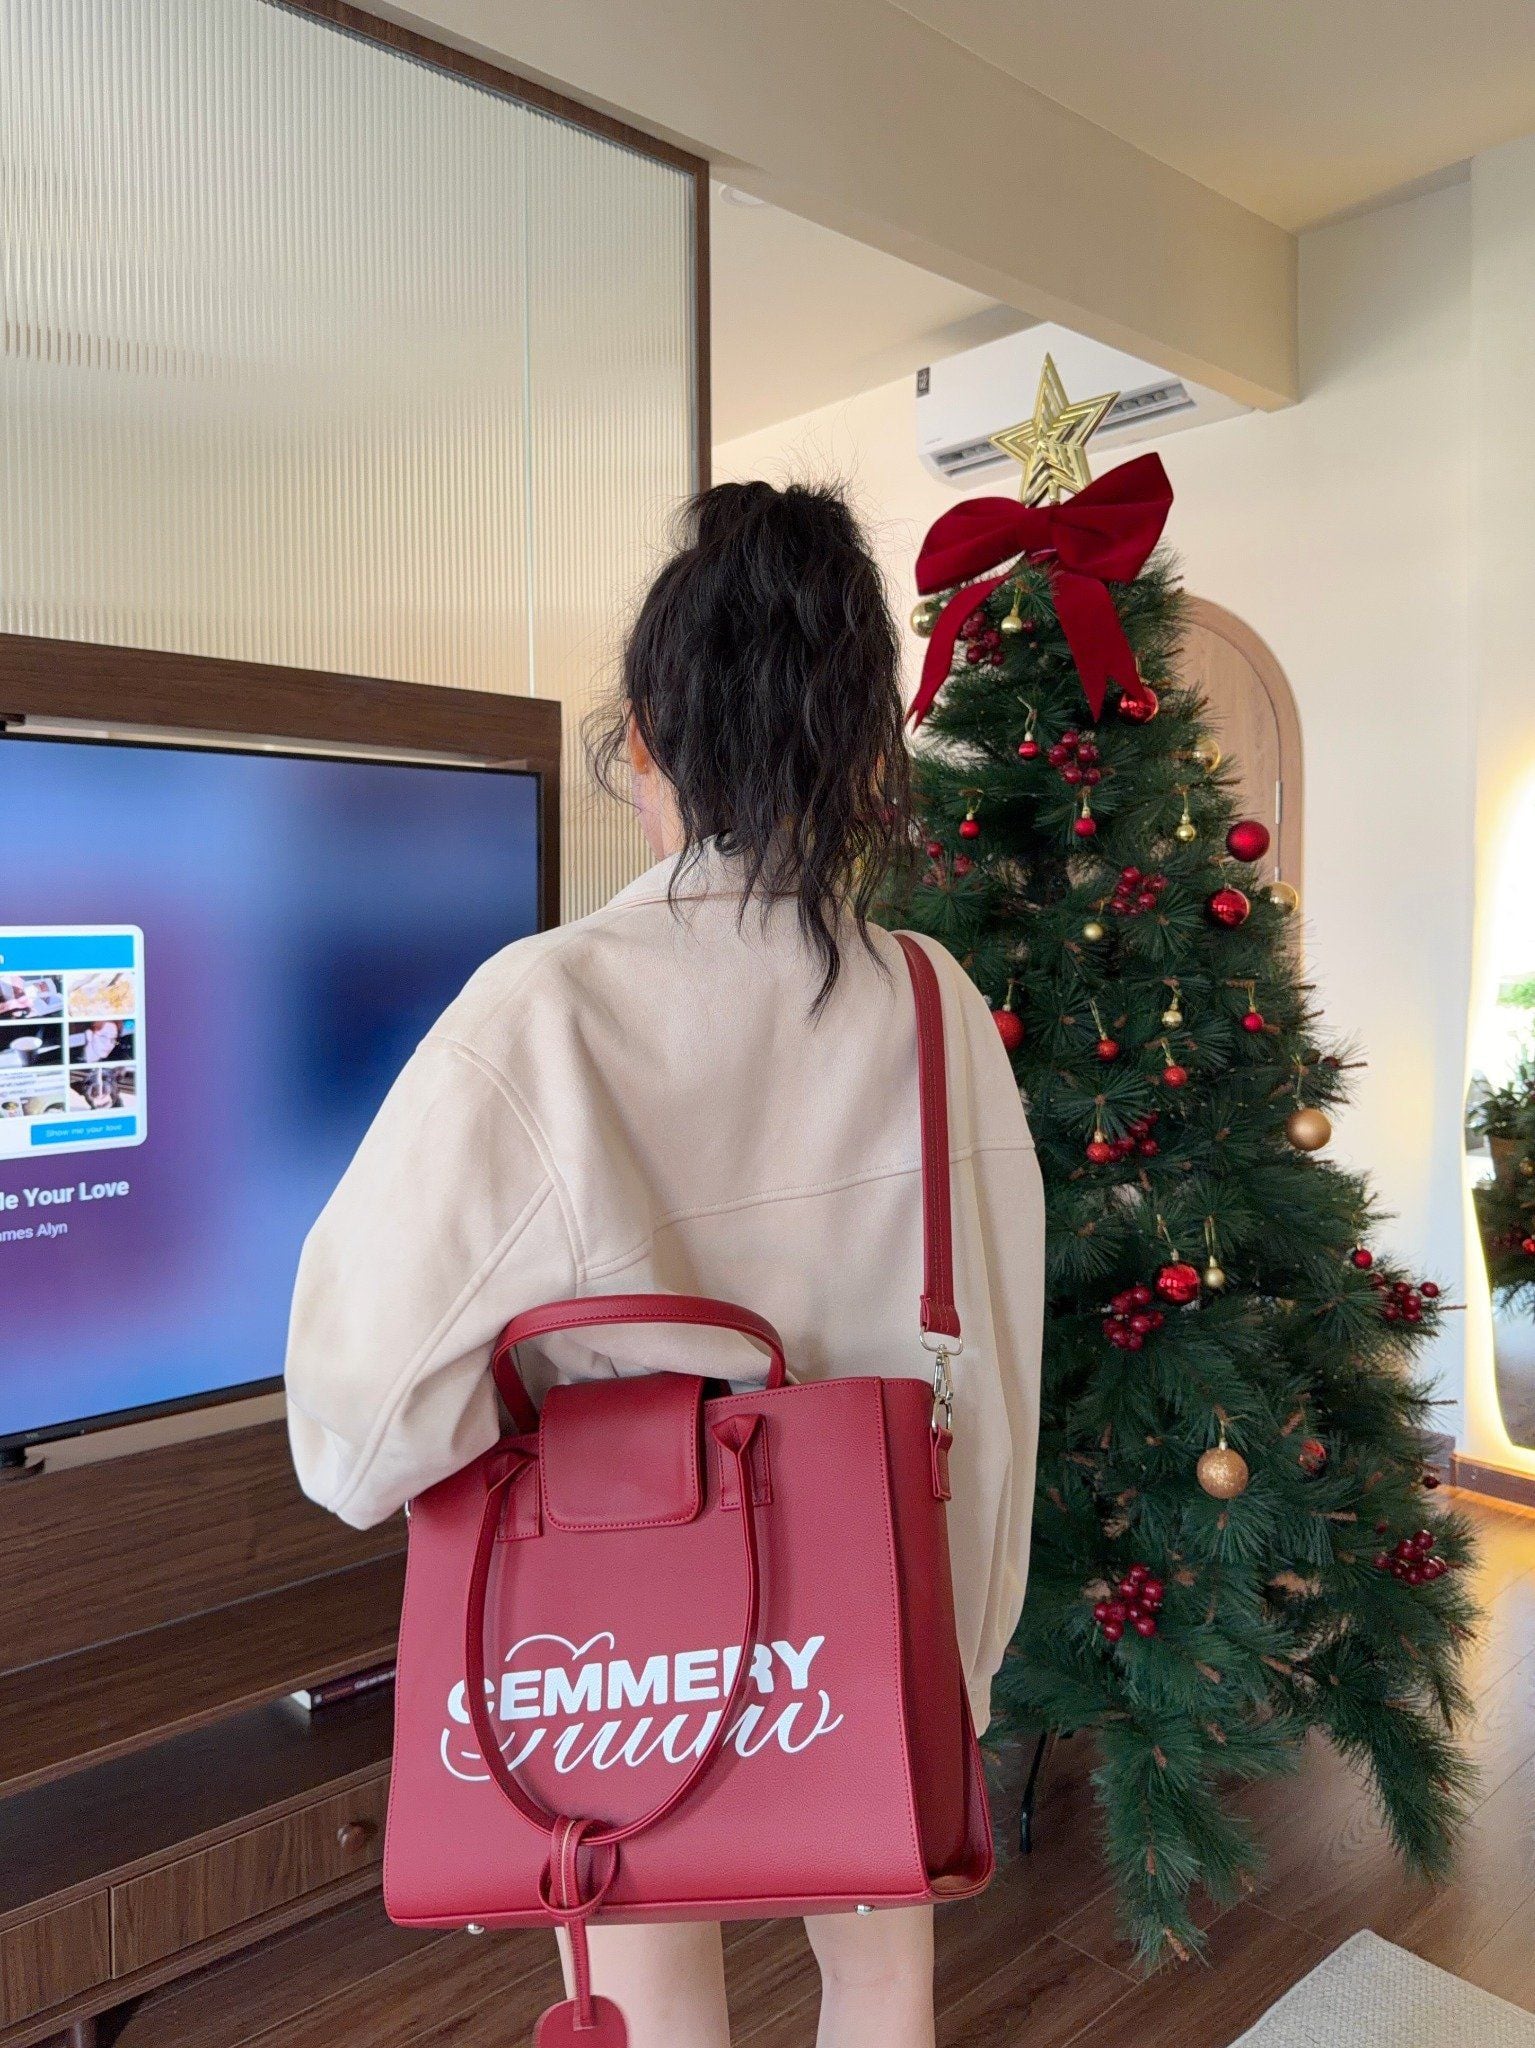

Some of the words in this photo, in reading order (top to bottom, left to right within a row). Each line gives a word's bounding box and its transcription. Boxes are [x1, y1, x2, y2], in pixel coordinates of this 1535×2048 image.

[23, 1187, 75, 1208] Your
[79, 1181, 130, 1201] Love
[0, 1228, 34, 1242] mes
[36, 1222, 68, 1239] Alyn
